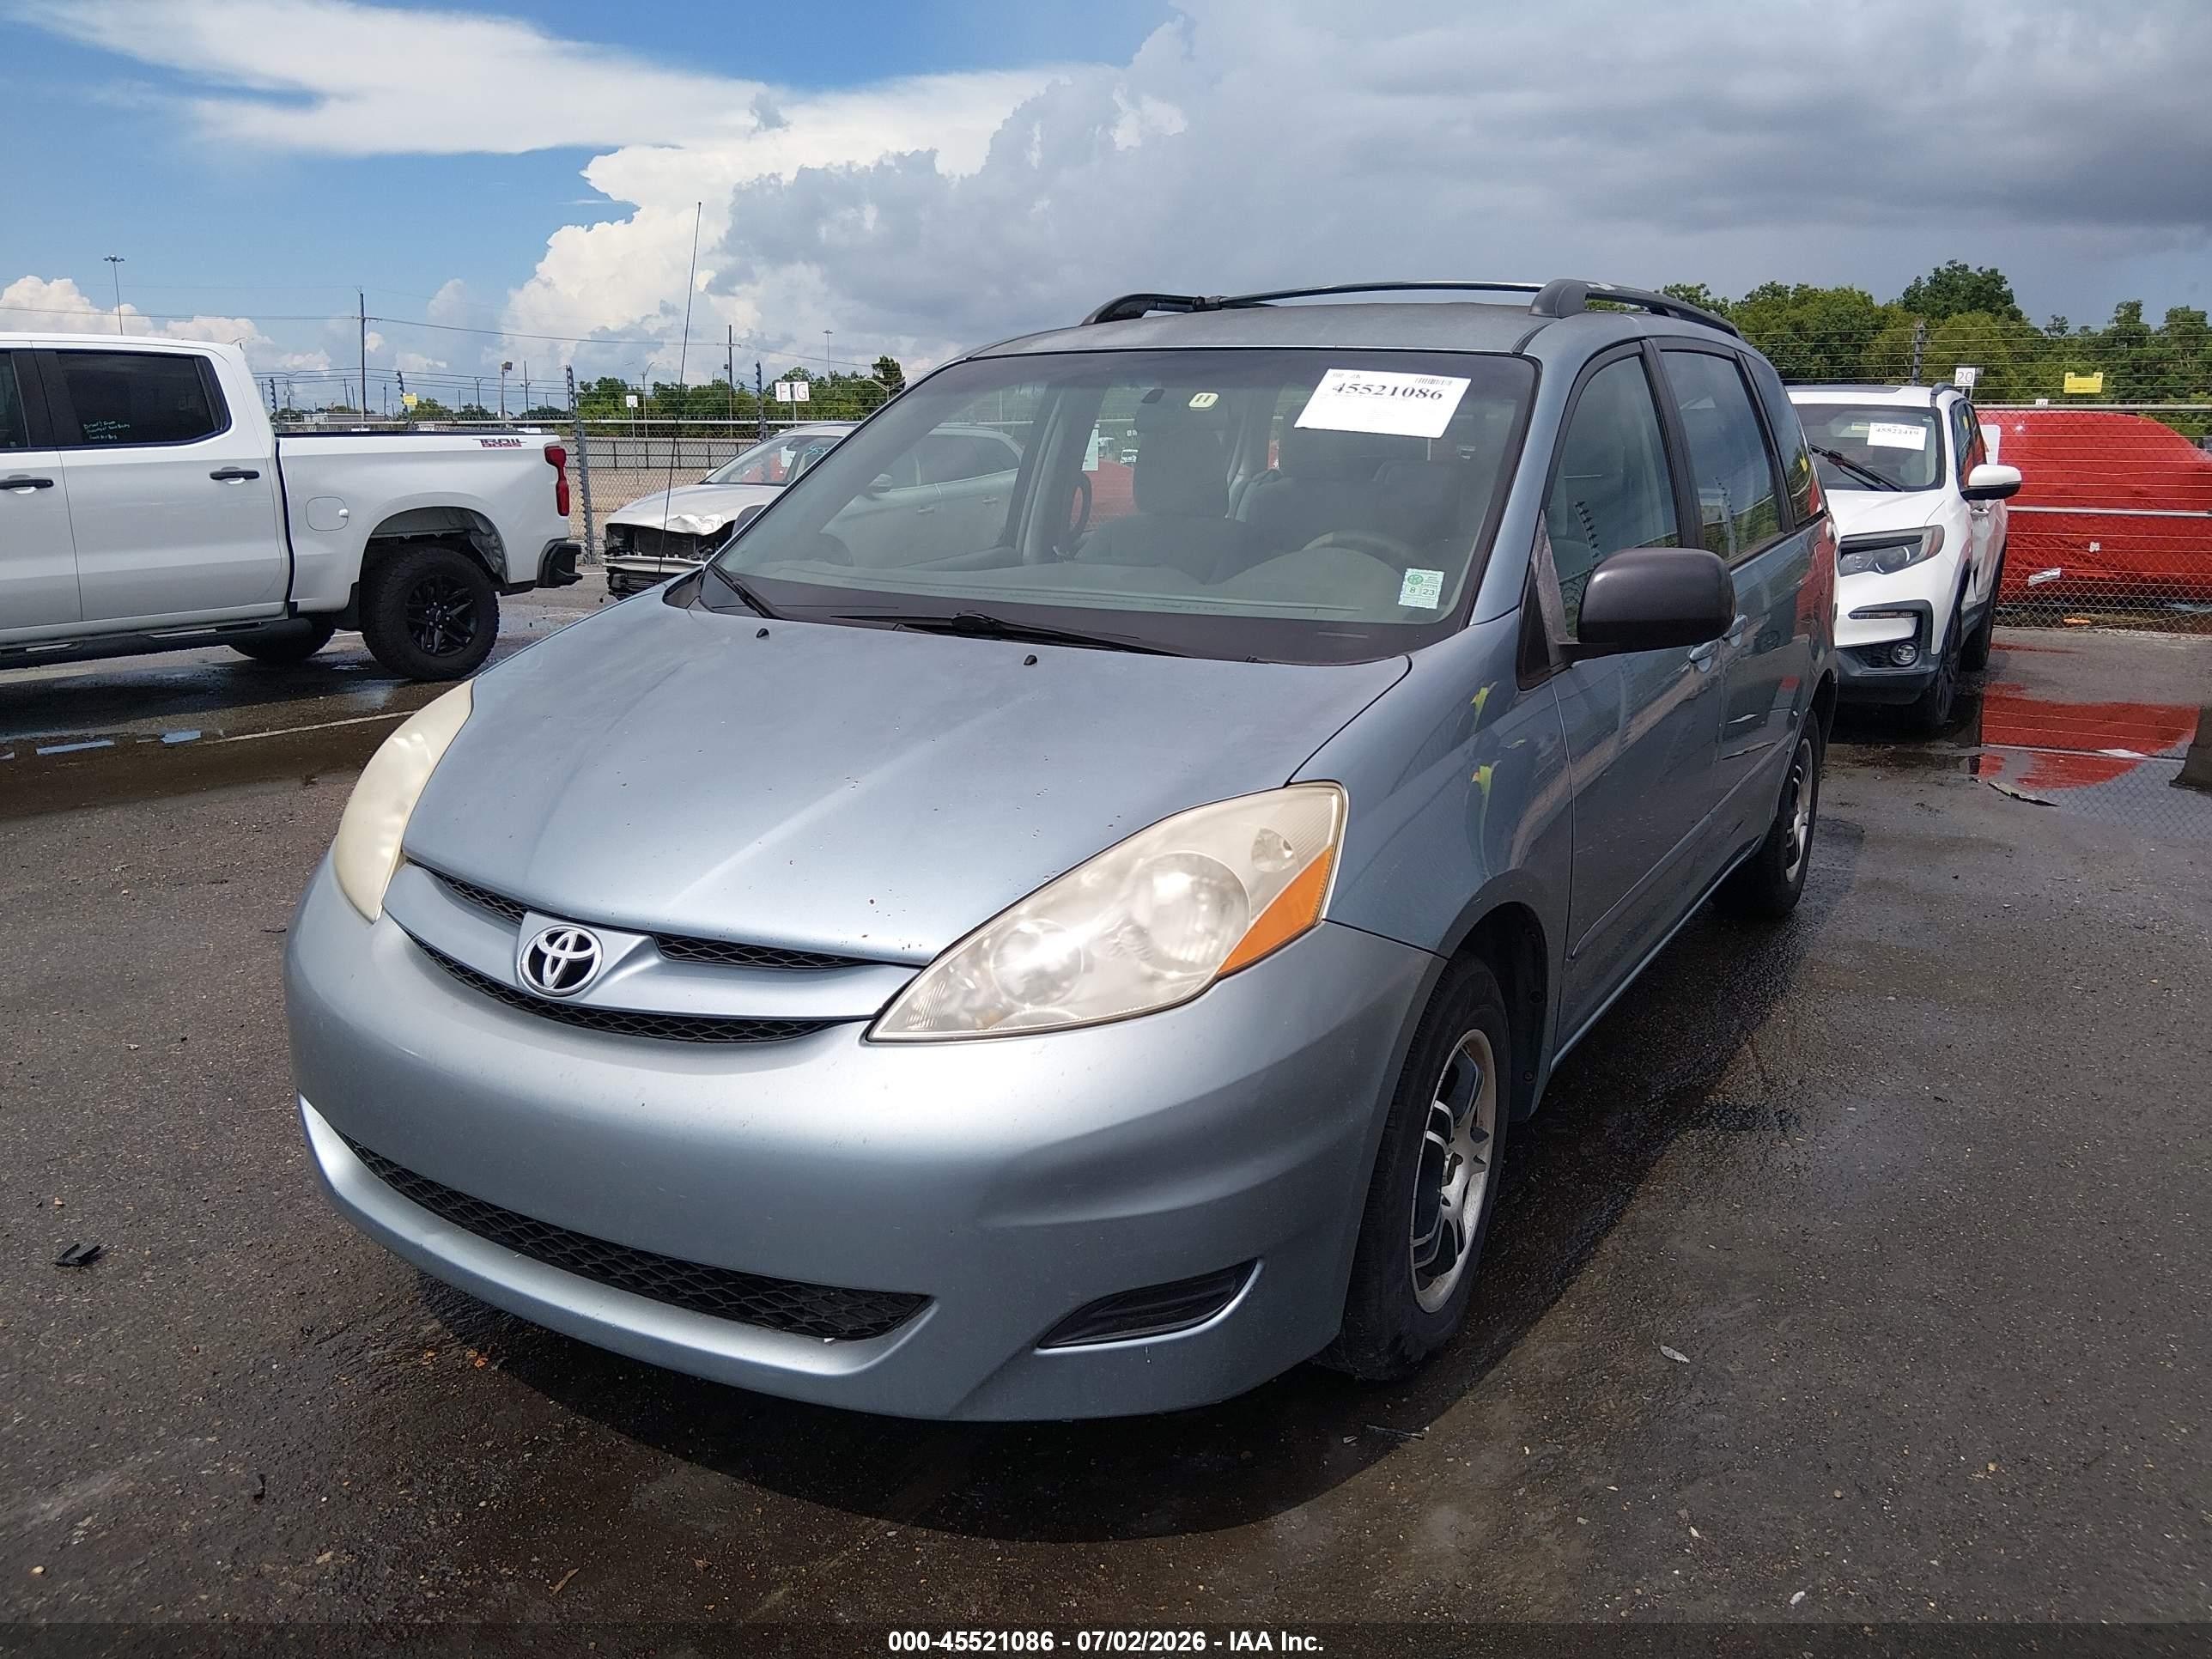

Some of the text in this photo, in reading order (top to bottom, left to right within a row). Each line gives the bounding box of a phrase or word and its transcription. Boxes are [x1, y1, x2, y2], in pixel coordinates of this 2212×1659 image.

[1956, 371, 1973, 384] 20
[780, 383, 787, 400] F
[796, 383, 807, 400] G
[1332, 383, 1443, 400] 45521086
